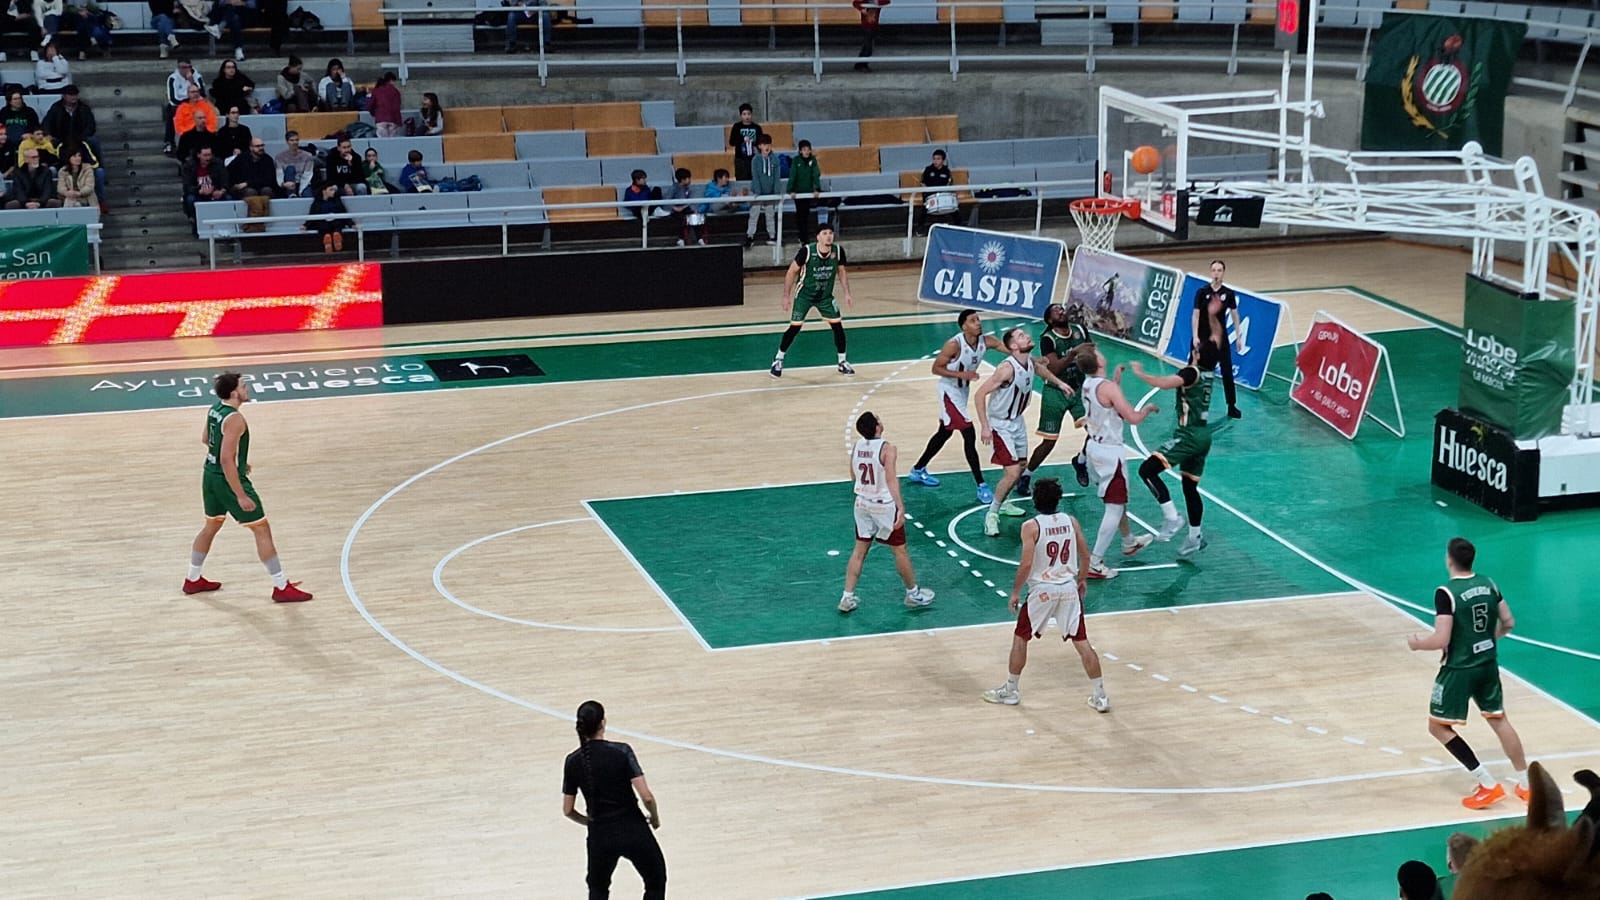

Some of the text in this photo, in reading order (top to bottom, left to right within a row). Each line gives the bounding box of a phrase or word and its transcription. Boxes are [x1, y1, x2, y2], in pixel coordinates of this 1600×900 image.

[12, 248, 51, 266] San
[934, 268, 1042, 309] GASBY
[1148, 289, 1169, 312] es
[1141, 316, 1161, 339] ca
[1467, 328, 1518, 364] Lobe
[90, 363, 424, 391] Ayunamiento
[252, 373, 434, 393] Huesca
[1318, 356, 1363, 400] Lobe
[1438, 425, 1508, 492] Huesca
[858, 463, 875, 485] 21
[1046, 539, 1071, 567] 96
[1472, 603, 1488, 632] 5
